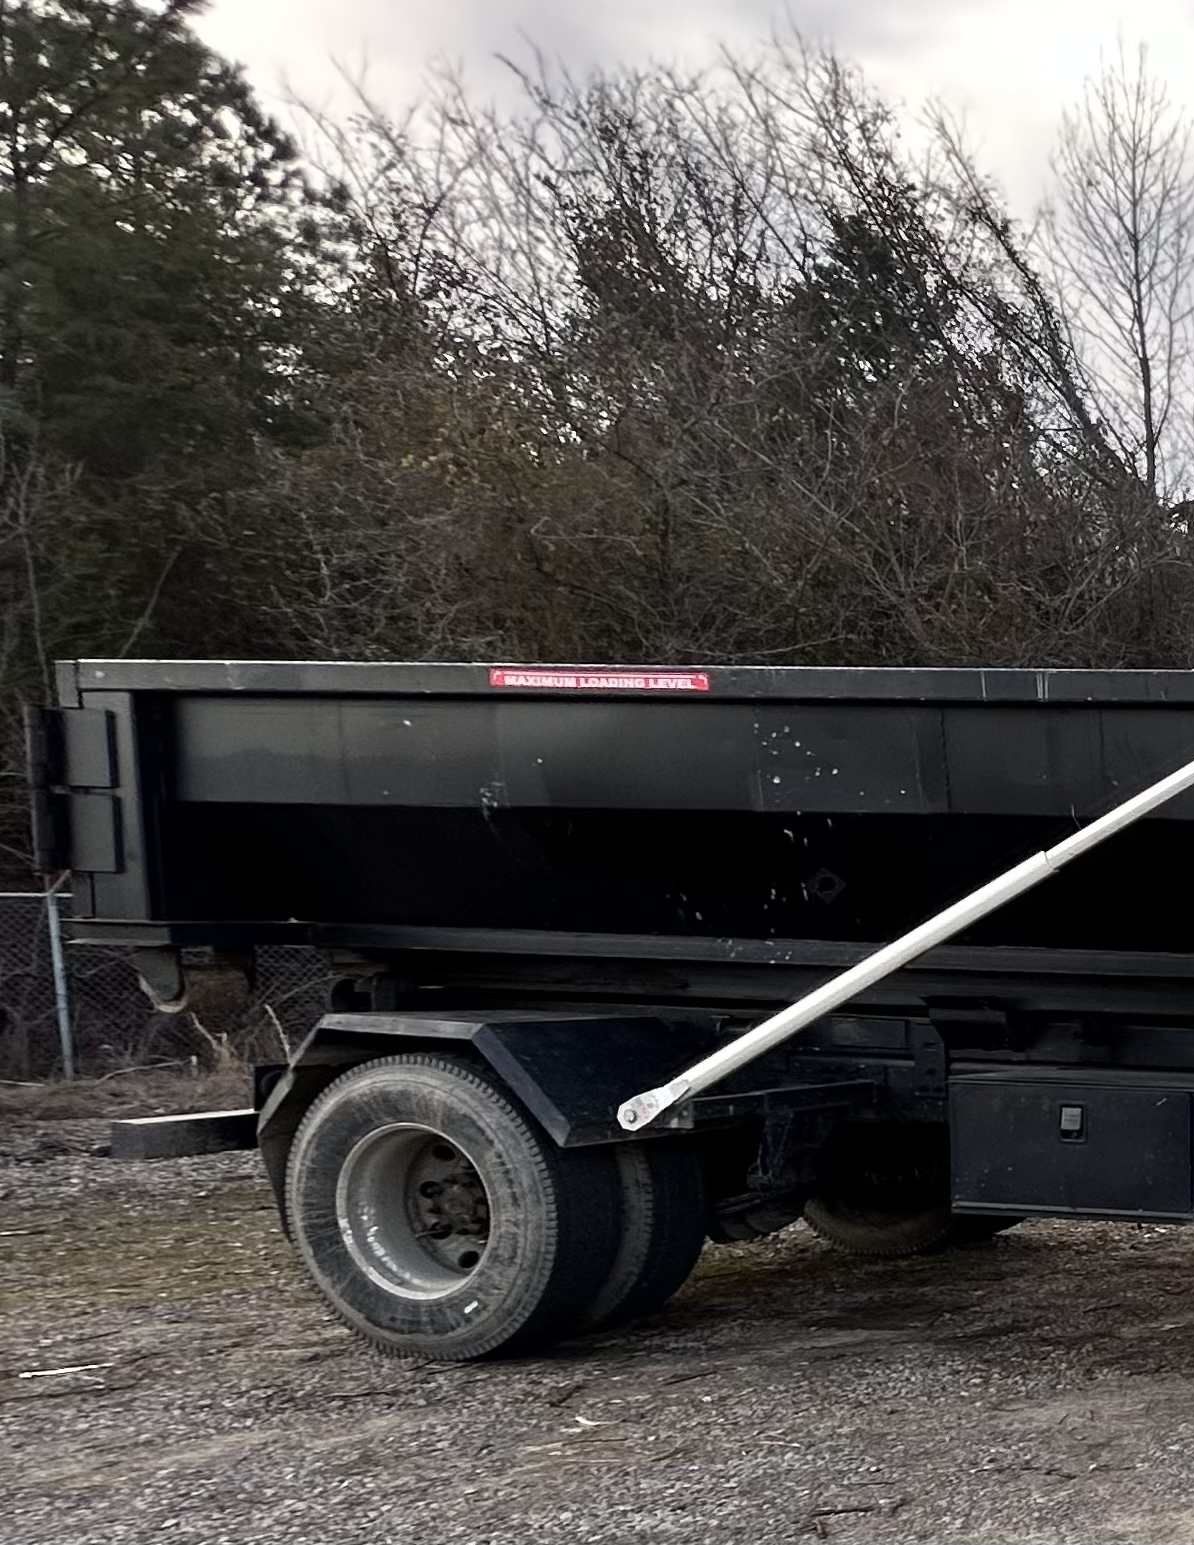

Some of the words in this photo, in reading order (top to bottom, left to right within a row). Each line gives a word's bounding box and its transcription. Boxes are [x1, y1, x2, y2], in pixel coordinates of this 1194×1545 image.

[504, 675, 577, 688] MAXIMUM
[579, 677, 645, 689] LOADING
[647, 678, 696, 689] LEVEL
